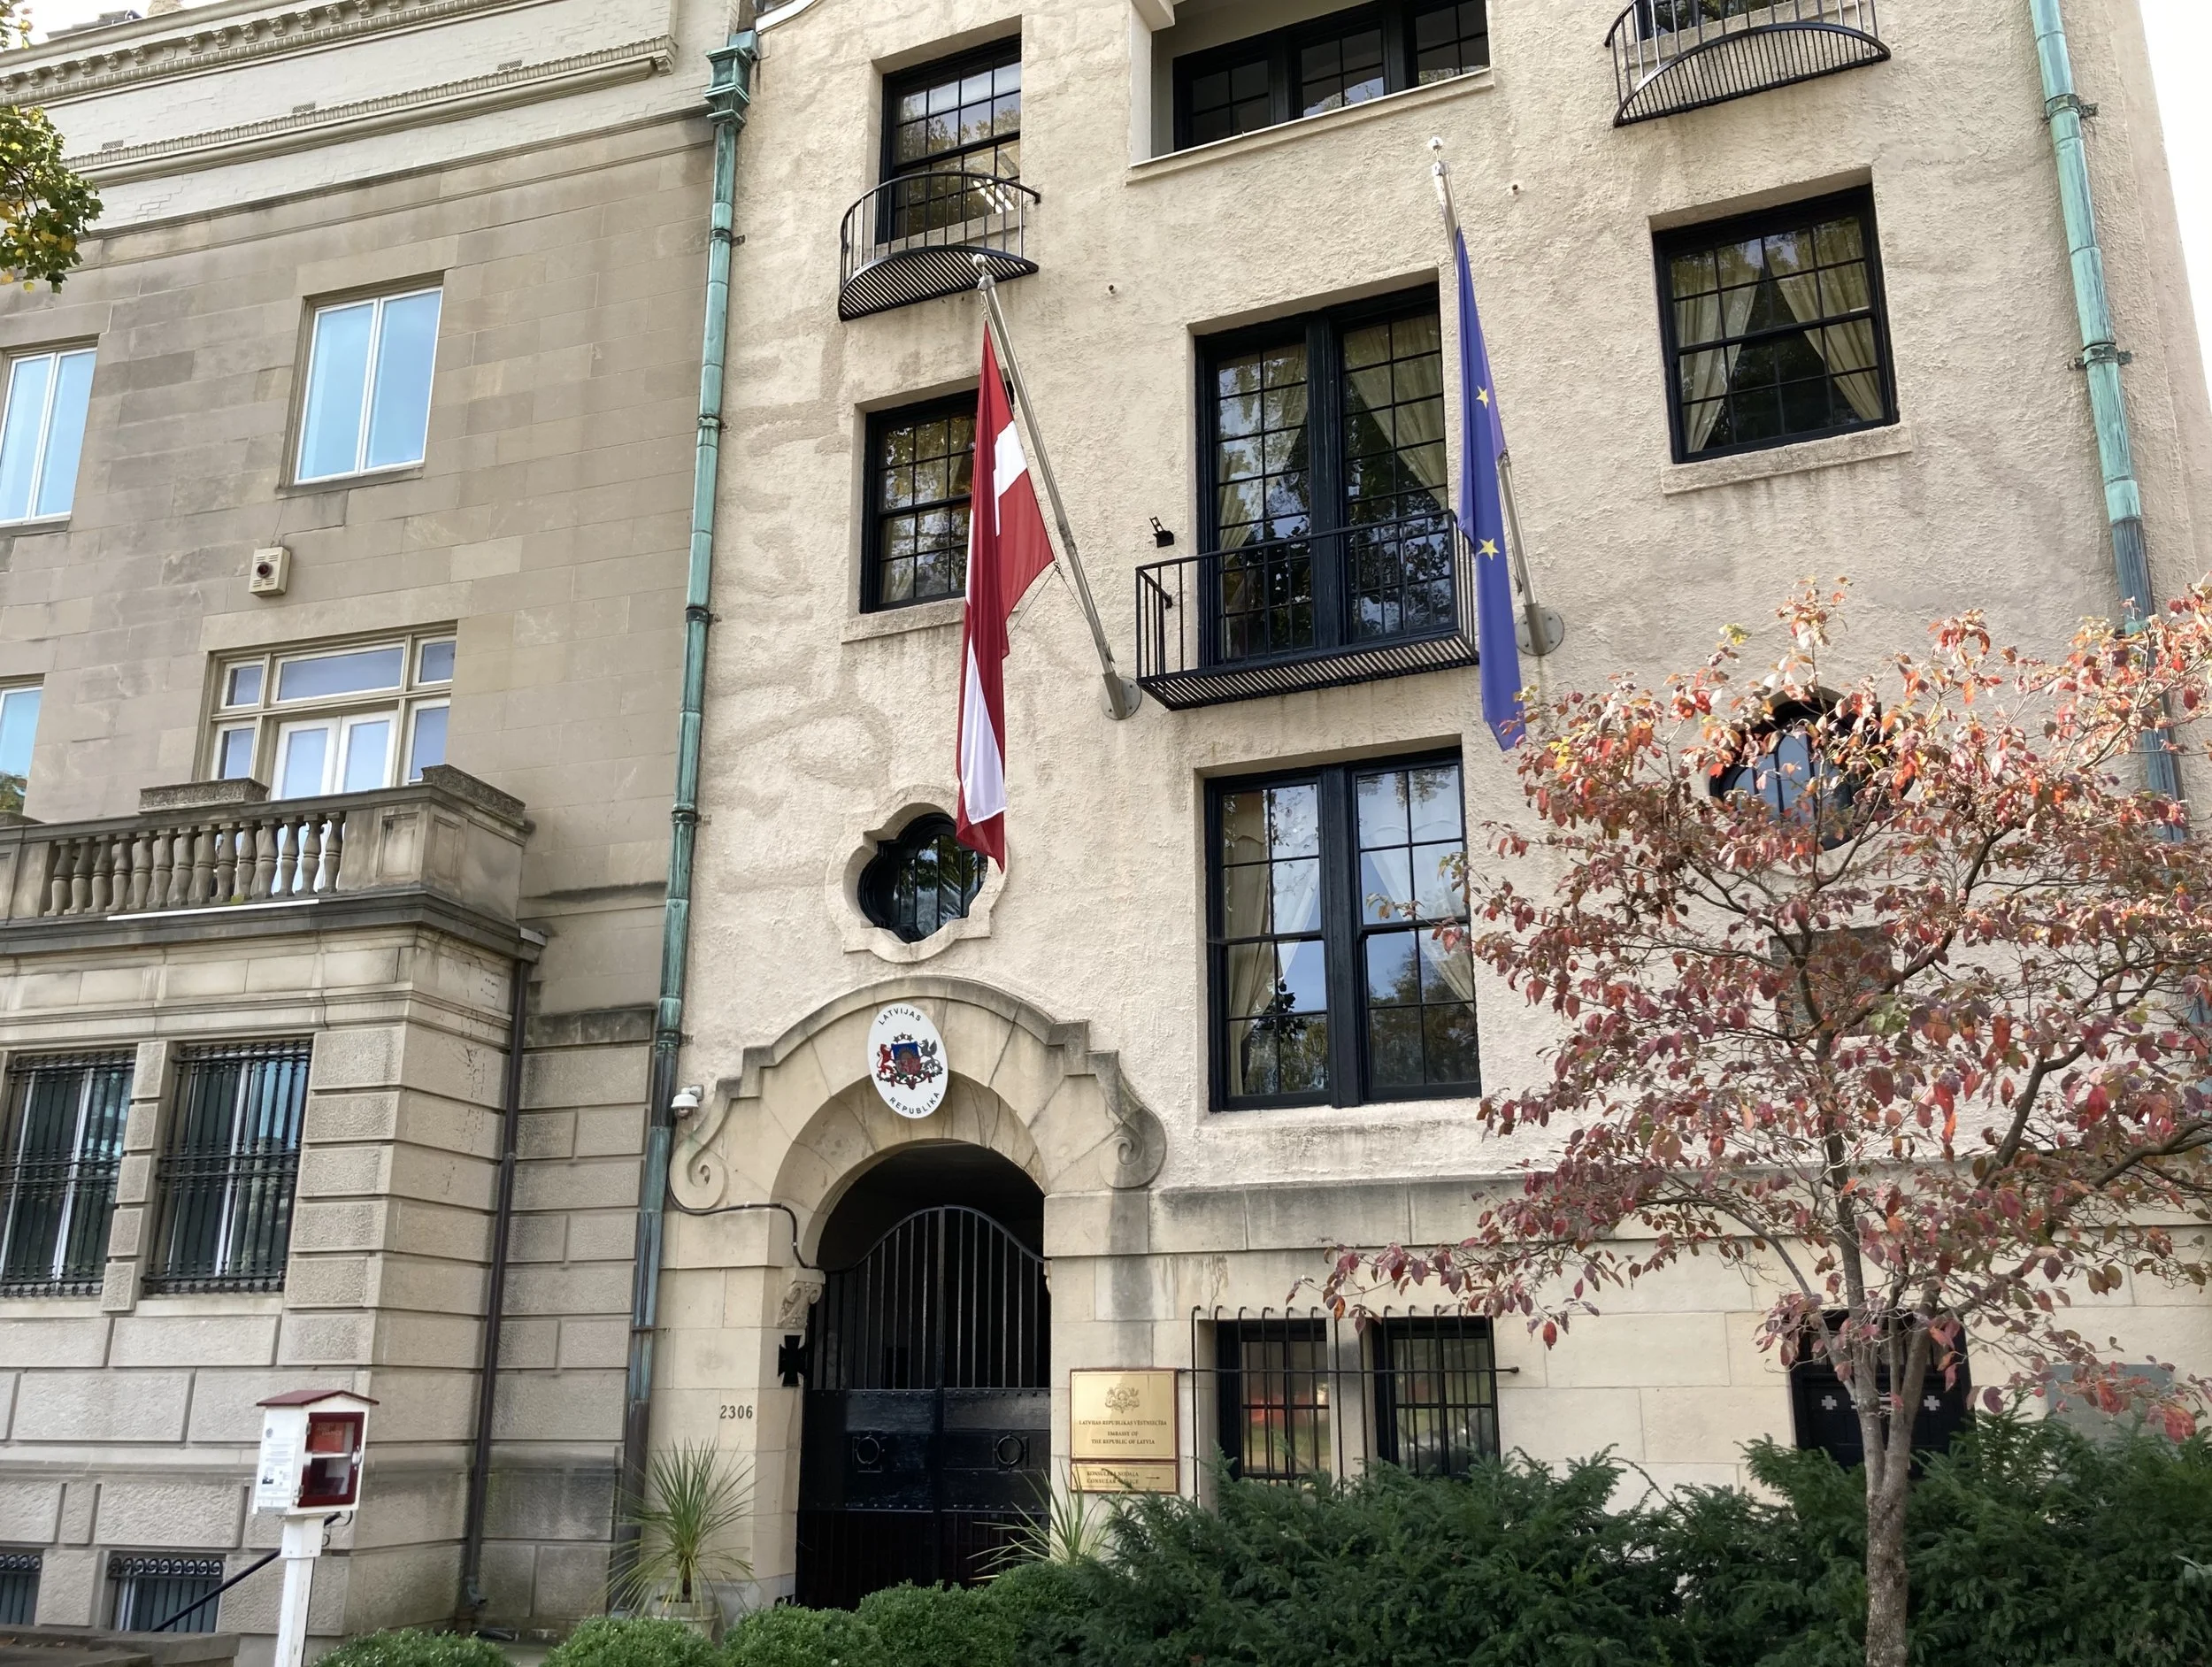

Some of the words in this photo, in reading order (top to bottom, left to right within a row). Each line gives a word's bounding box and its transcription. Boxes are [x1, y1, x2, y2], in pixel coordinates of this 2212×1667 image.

[879, 1007, 922, 1026] LATVIJAS
[889, 1091, 940, 1115] REPUBLIKA
[719, 1404, 753, 1419] 2306
